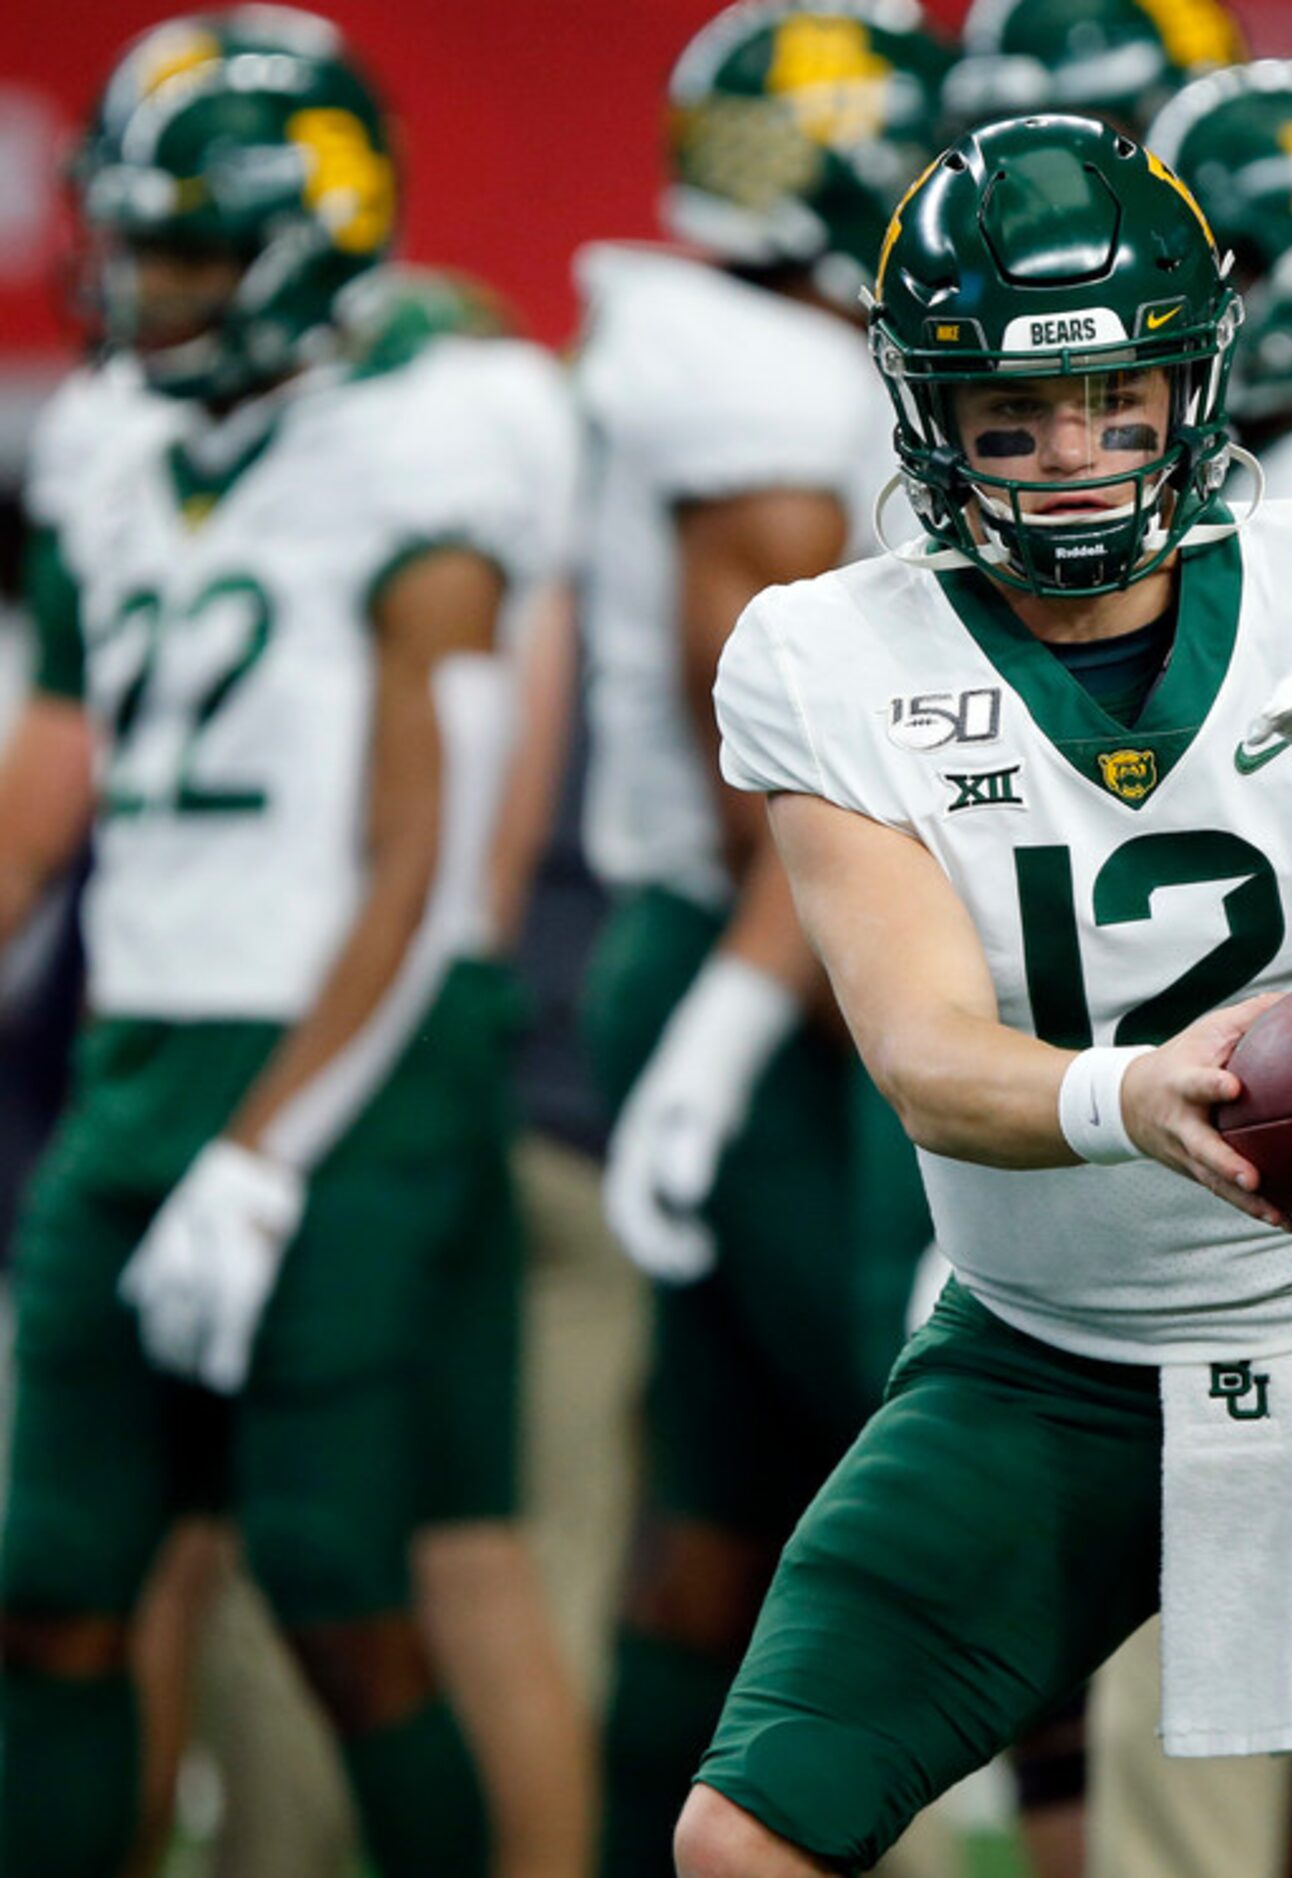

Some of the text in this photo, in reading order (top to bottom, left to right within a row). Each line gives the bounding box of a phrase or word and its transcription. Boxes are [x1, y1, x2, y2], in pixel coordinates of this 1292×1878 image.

[1031, 318, 1096, 346] BEARS
[1055, 543, 1108, 559] Riddell
[889, 686, 1001, 751] 150
[944, 764, 1023, 812] XII
[1013, 829, 1286, 1050] 12
